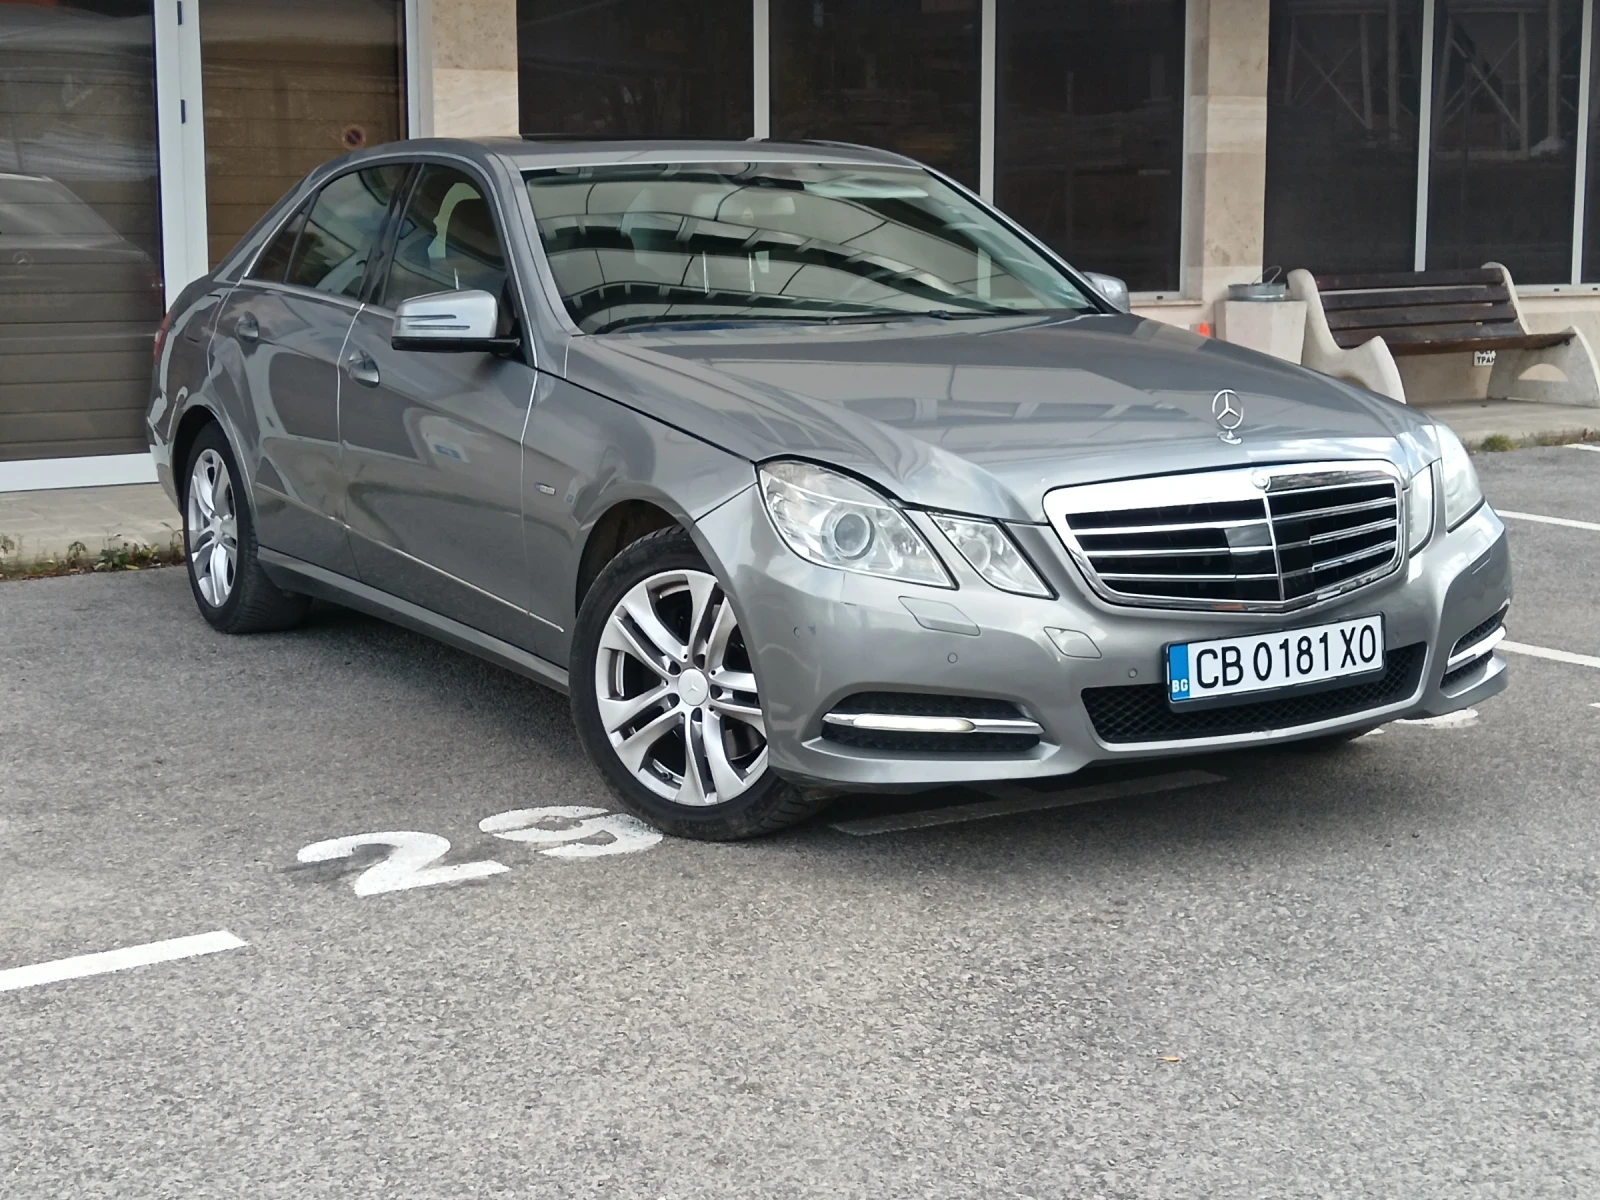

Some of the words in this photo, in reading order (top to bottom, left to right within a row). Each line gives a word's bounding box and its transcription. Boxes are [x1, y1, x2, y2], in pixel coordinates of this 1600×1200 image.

[1171, 678, 1189, 693] BG
[1196, 645, 1244, 689] CB
[1253, 632, 1330, 681] 0181
[1340, 624, 1377, 669] XO
[296, 805, 664, 897] 29
